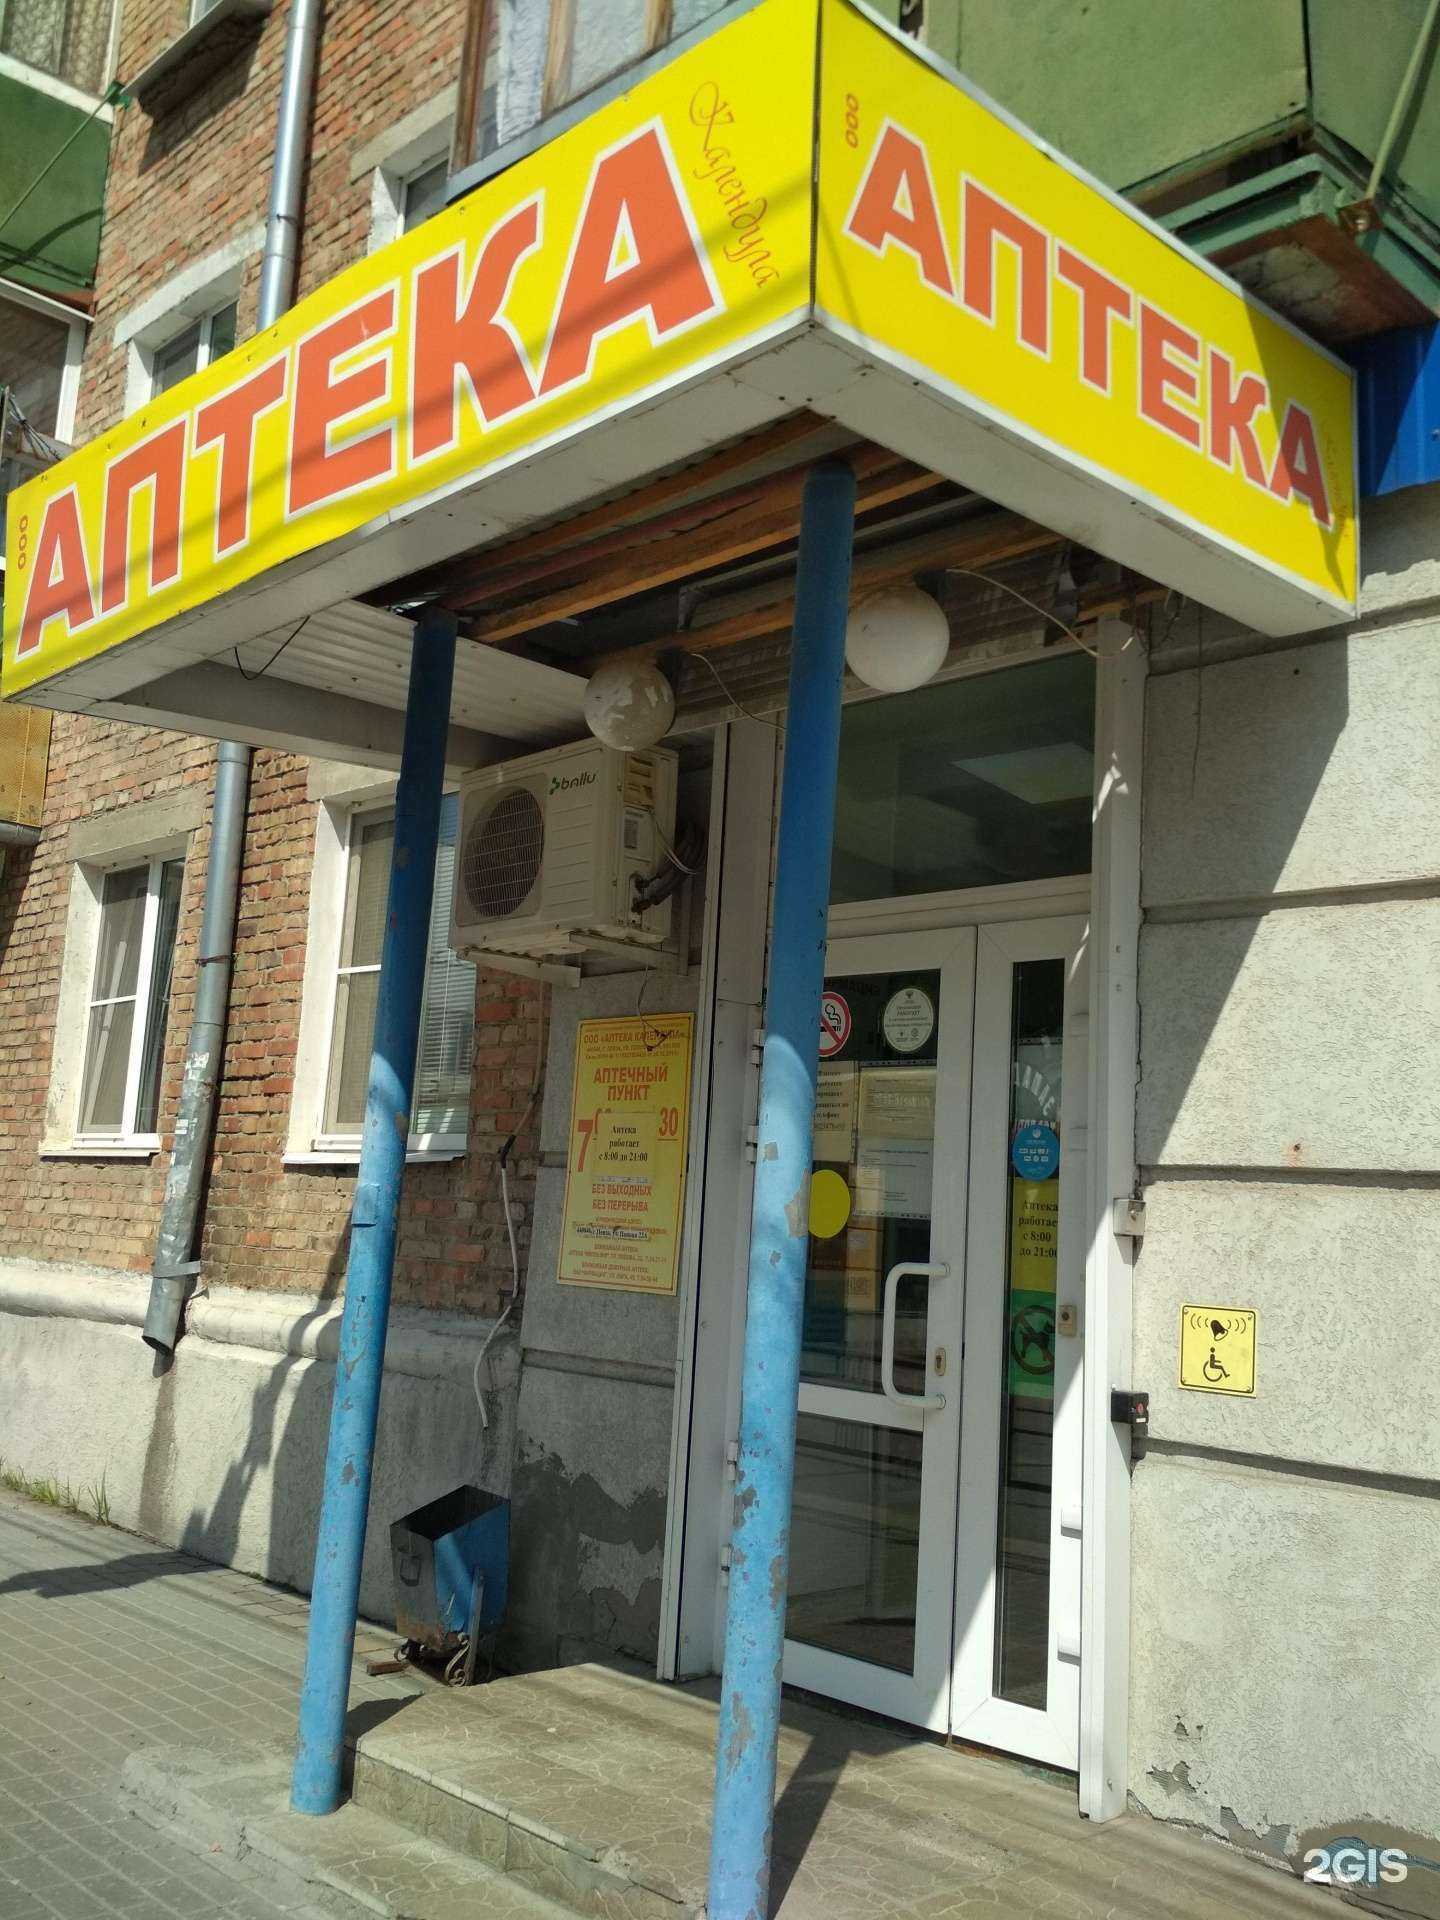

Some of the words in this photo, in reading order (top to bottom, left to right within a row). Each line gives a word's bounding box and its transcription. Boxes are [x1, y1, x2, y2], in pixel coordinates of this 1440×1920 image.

[841, 116, 1338, 533] АПТЕКА
[14, 115, 728, 664] АПТЕКА
[594, 1062, 668, 1084] АПТЕЧНЫЙ
[608, 1085, 651, 1101] ПУНКТ
[658, 1107, 679, 1136] 30
[613, 1125, 638, 1135] Аптека
[578, 1119, 594, 1173] 7
[609, 1140, 641, 1150] работает
[603, 1152, 619, 1161] 8:00
[629, 1152, 648, 1161] 21:00
[592, 1184, 606, 1194] БЕЗ
[606, 1184, 653, 1197] ВЫХОДНЫХ
[592, 1199, 606, 1210] БЕЗ
[607, 1200, 649, 1212] ПЕРЕРЫВА
[1023, 1200, 1058, 1211] Аптека
[1030, 1231, 1052, 1241] 8:00
